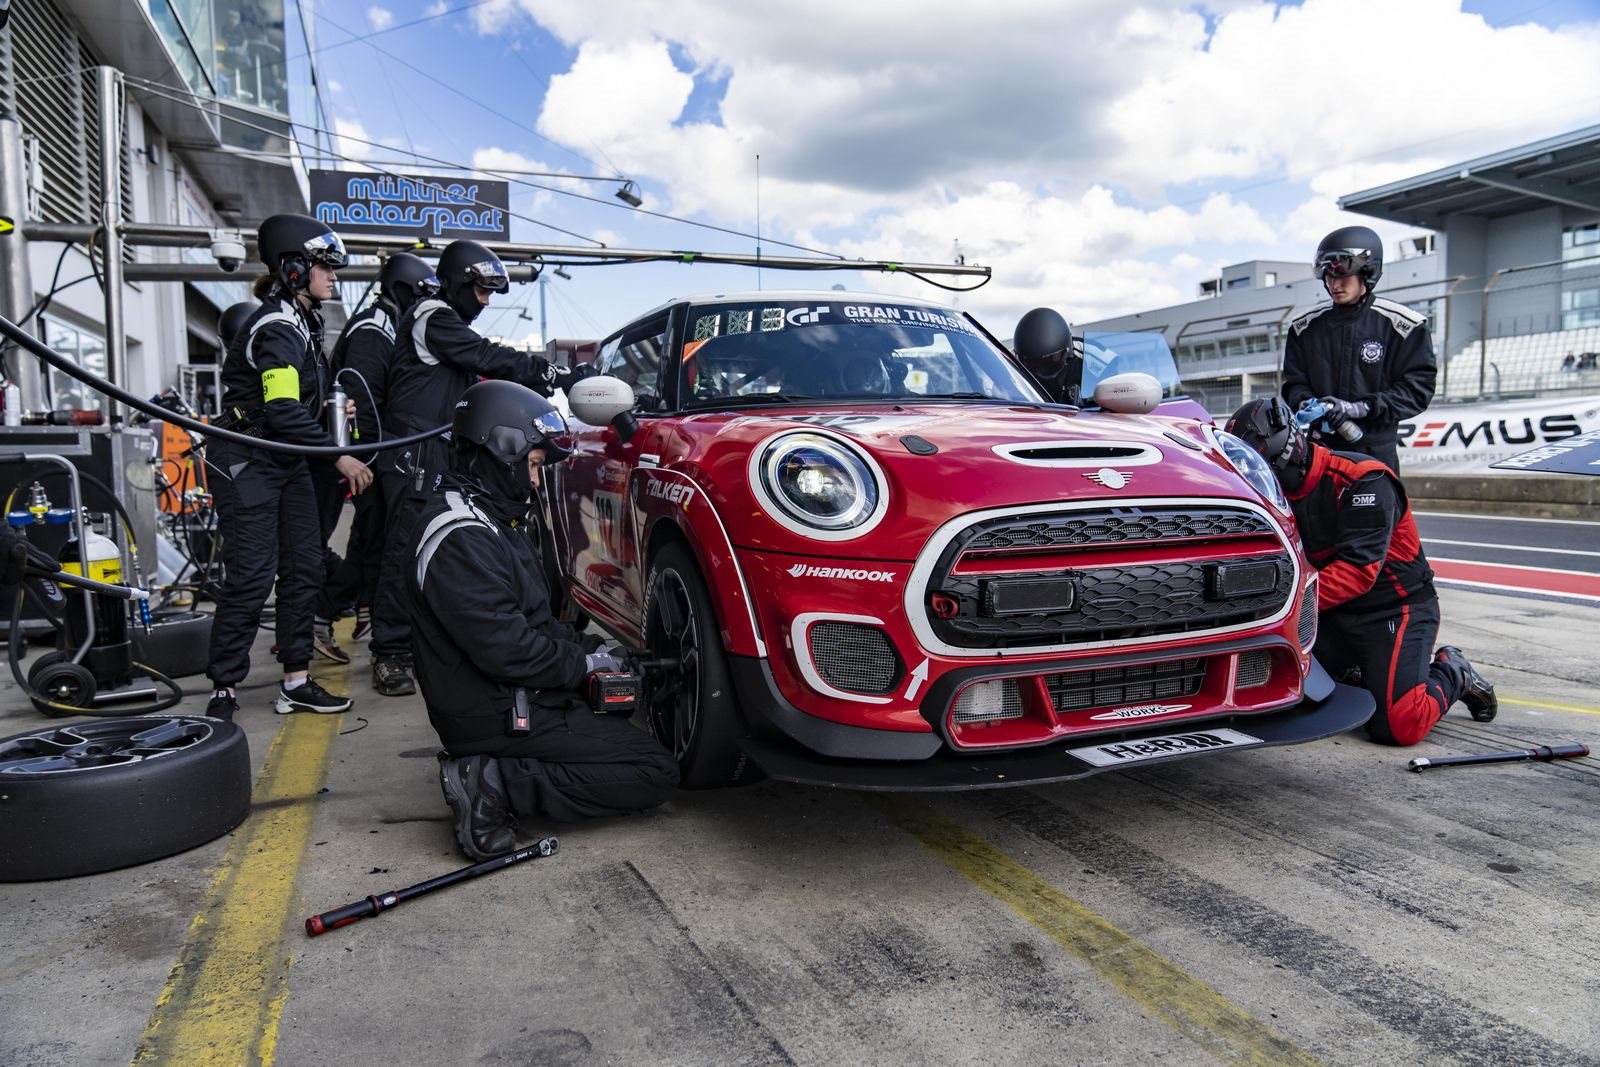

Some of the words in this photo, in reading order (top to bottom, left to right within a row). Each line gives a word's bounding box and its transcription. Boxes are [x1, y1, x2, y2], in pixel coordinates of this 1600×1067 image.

[316, 201, 504, 235] motorsport
[844, 306, 901, 319] GRAN
[1398, 415, 1581, 448] REMUS
[646, 479, 695, 505] FALKEN
[1352, 495, 1376, 505] OMP
[1116, 706, 1168, 718] WORKS
